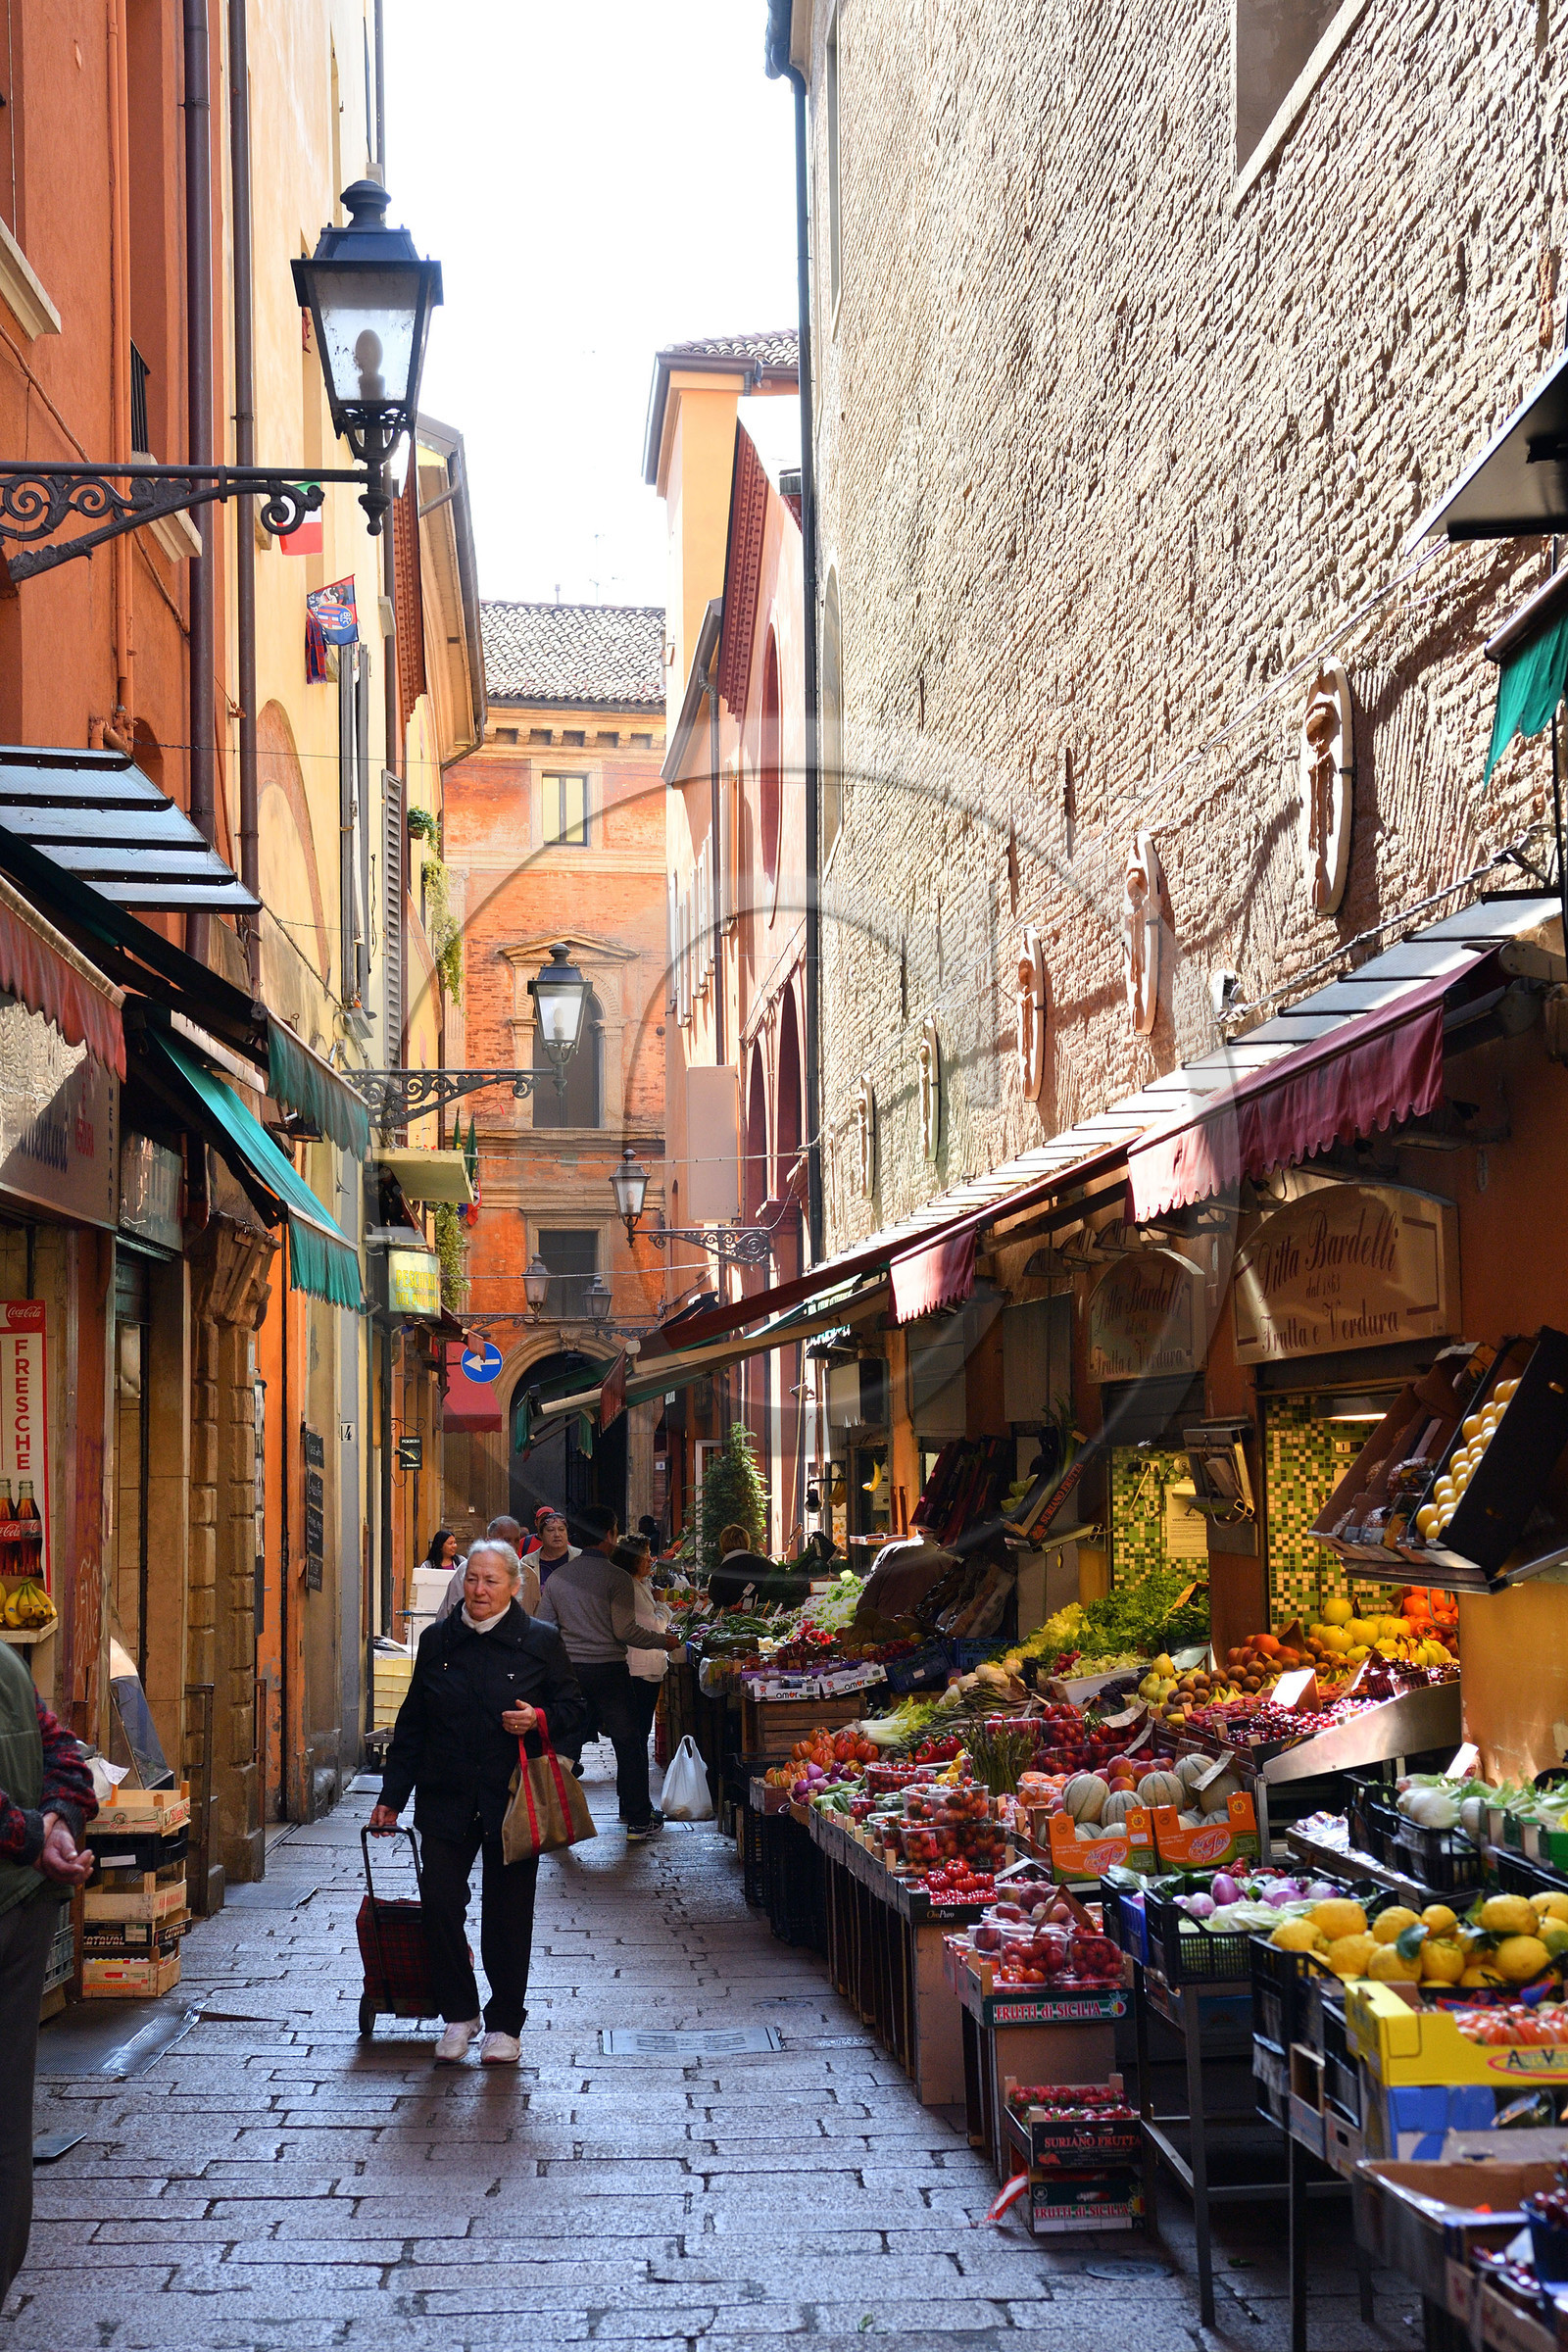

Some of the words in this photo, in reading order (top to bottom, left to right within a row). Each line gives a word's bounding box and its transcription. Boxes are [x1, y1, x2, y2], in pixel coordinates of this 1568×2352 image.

[1258, 1236, 1299, 1303] Ditta
[1305, 1208, 1398, 1272] Bardelli
[1260, 1315, 1308, 1353] Frutta
[1312, 1326, 1319, 1346] e
[1323, 1299, 1399, 1342] Verdura
[15, 1339, 30, 1470] FRESCHE
[341, 1425, 352, 1442] 14
[1059, 1462, 1084, 1493] FRUTTA
[996, 2005, 1038, 2021] FRUTTI
[1041, 2003, 1054, 2018] di
[1055, 2002, 1102, 2019] SICILIA
[1044, 2135, 1097, 2149] SURIANO
[1035, 2206, 1072, 2220] FRUTTI
[1075, 2205, 1087, 2217] di
[1090, 2204, 1130, 2217] SICILIA
